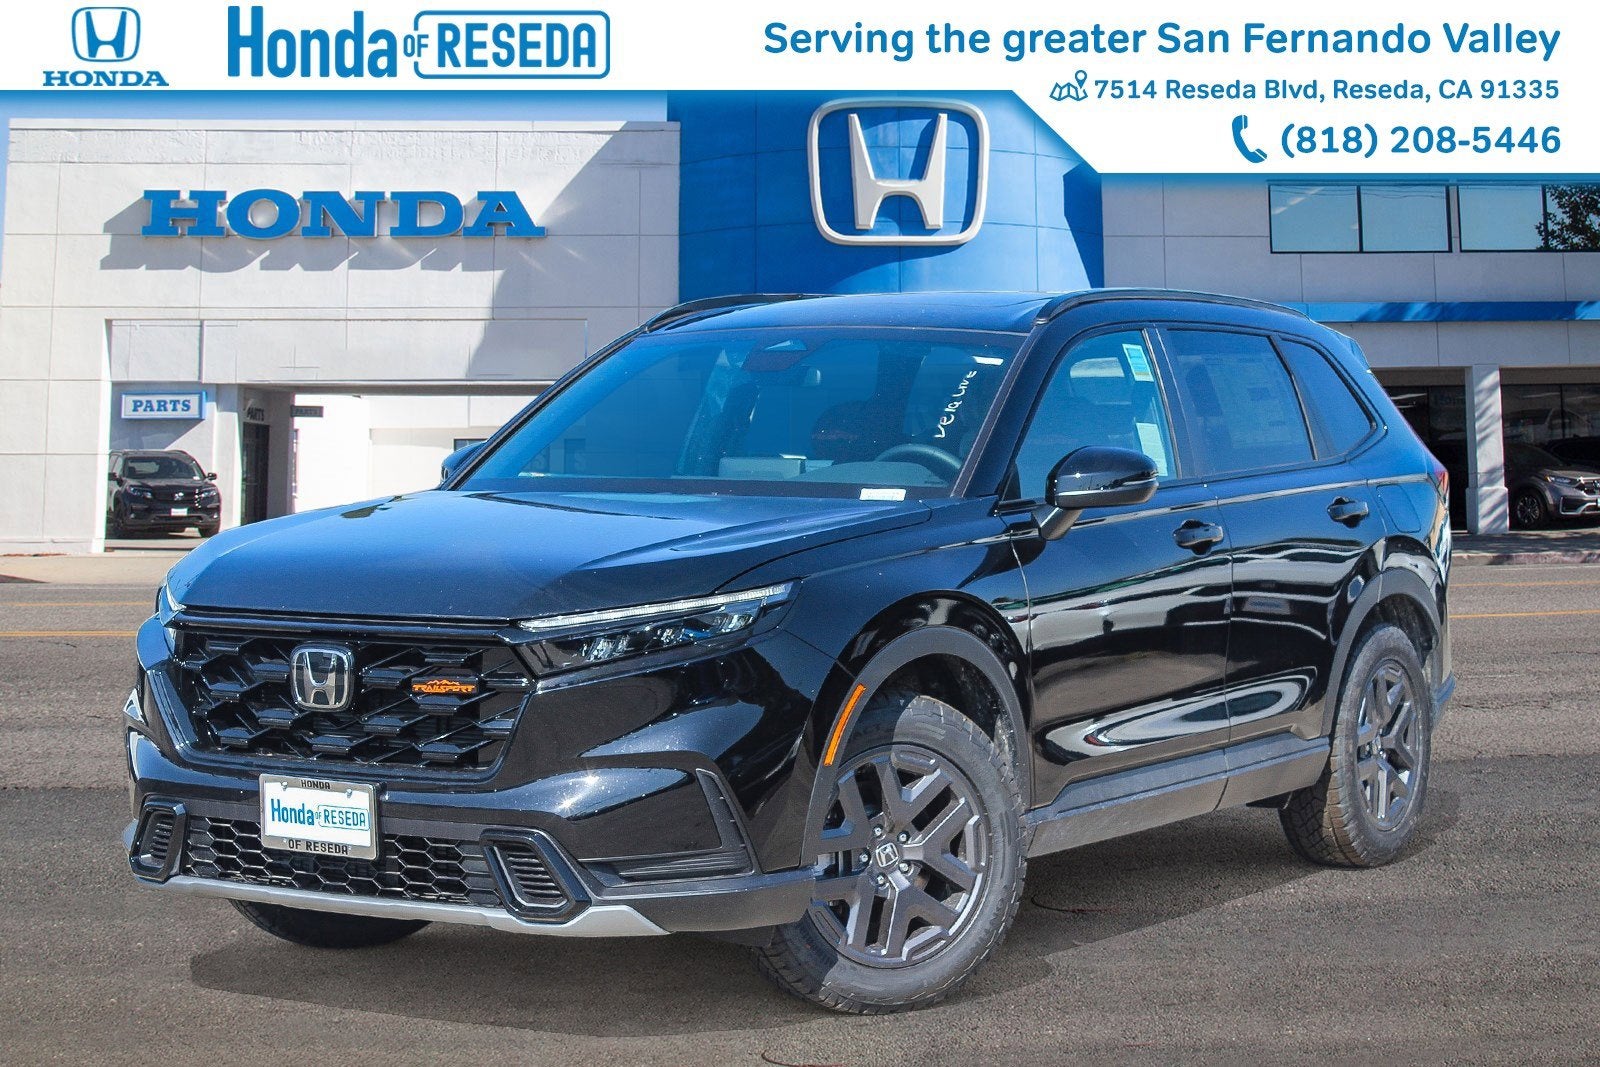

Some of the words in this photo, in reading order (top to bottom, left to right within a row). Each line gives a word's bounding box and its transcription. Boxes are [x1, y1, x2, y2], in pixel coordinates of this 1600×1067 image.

[142, 189, 548, 239] HONDA
[132, 399, 191, 412] PARTS
[301, 779, 331, 790] HONDA
[271, 798, 315, 826] Honda
[324, 808, 366, 827] RESEDA
[288, 838, 301, 850] OF
[305, 841, 349, 855] RESEDA
